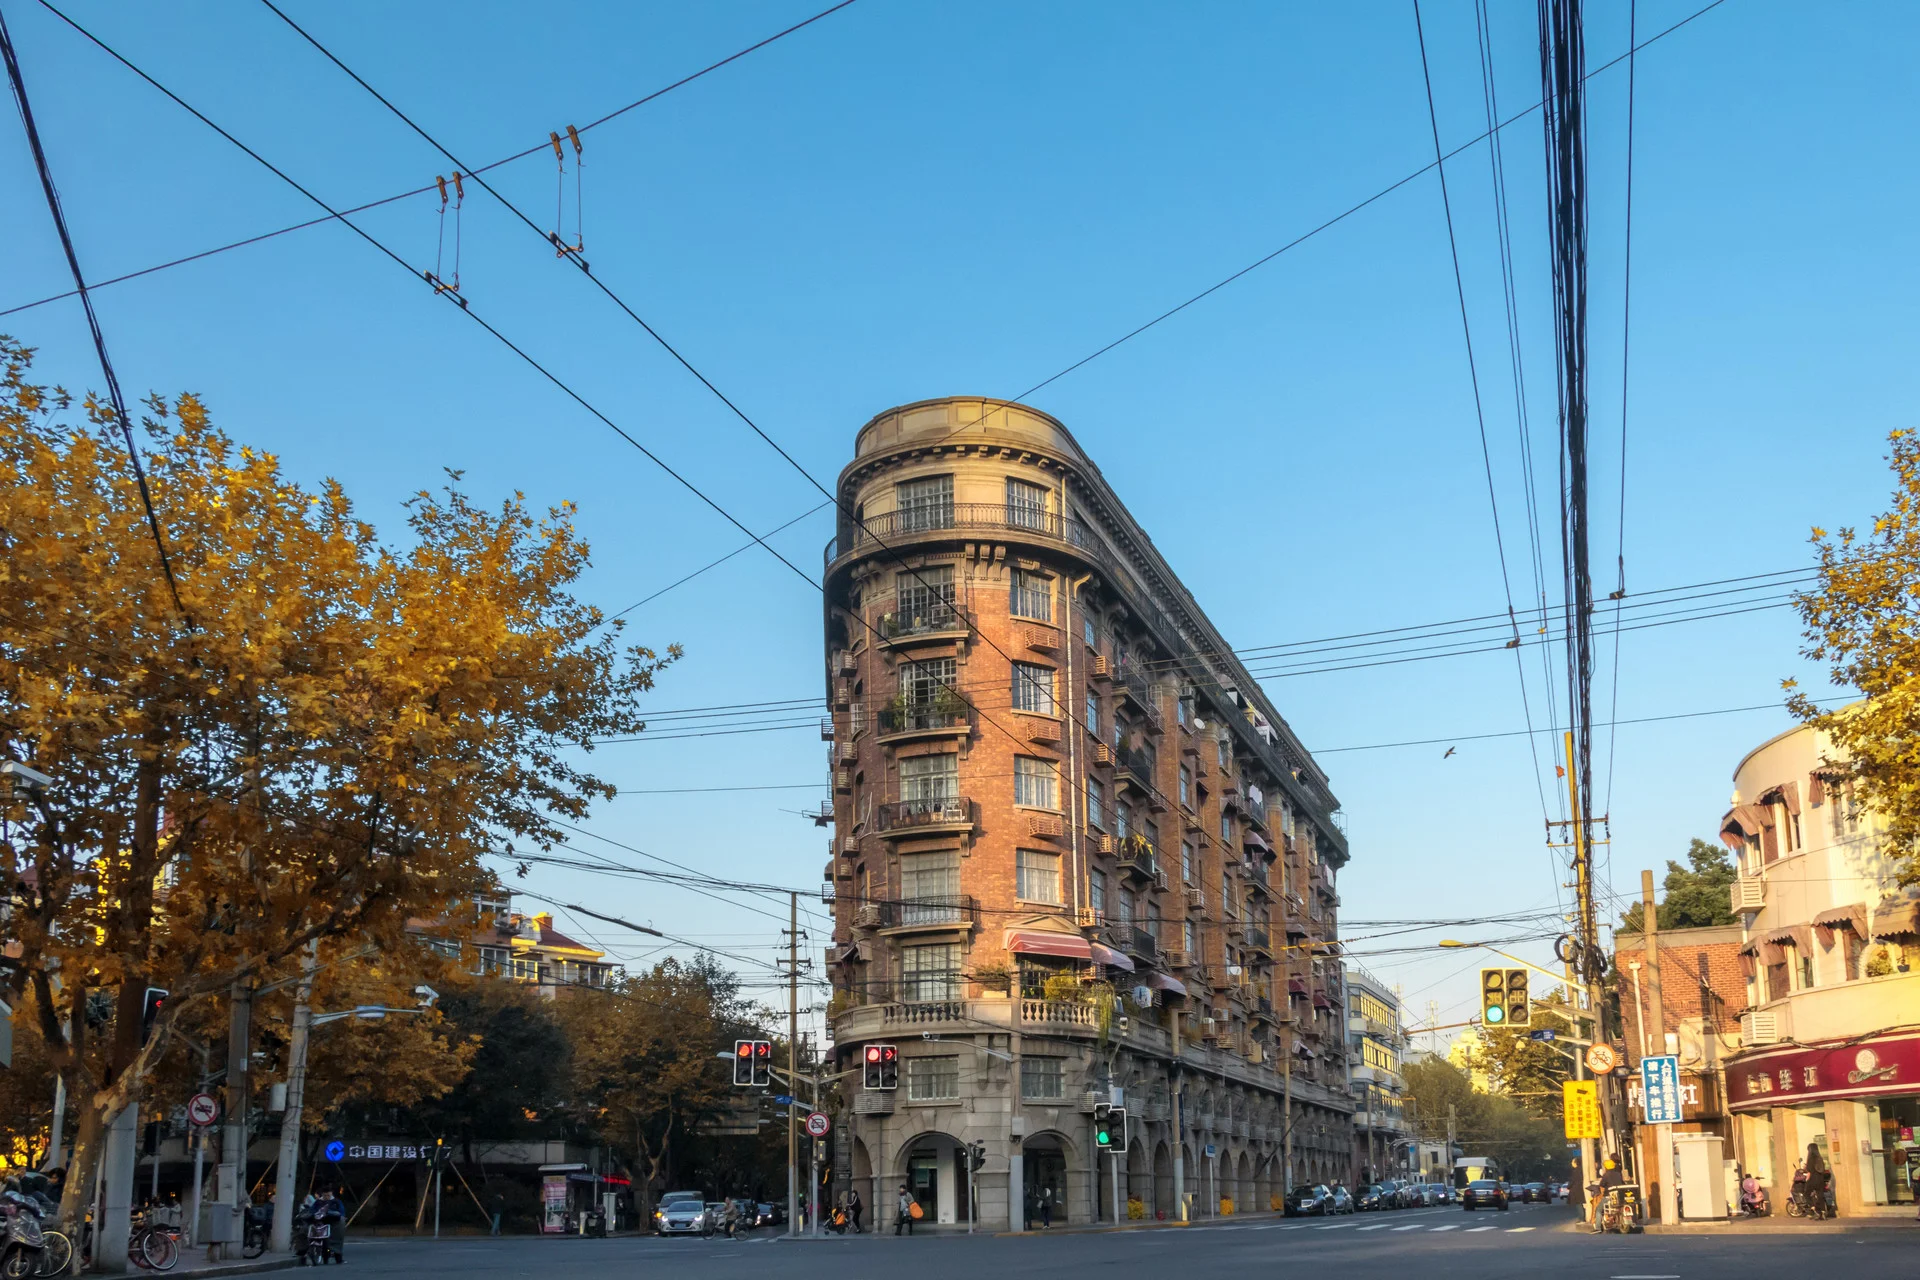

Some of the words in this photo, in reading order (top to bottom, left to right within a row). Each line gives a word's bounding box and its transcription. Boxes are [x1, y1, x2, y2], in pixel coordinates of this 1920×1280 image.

[1647, 1061, 1662, 1119] 请下车推行
[1661, 1059, 1677, 1119] 人行道非机动车
